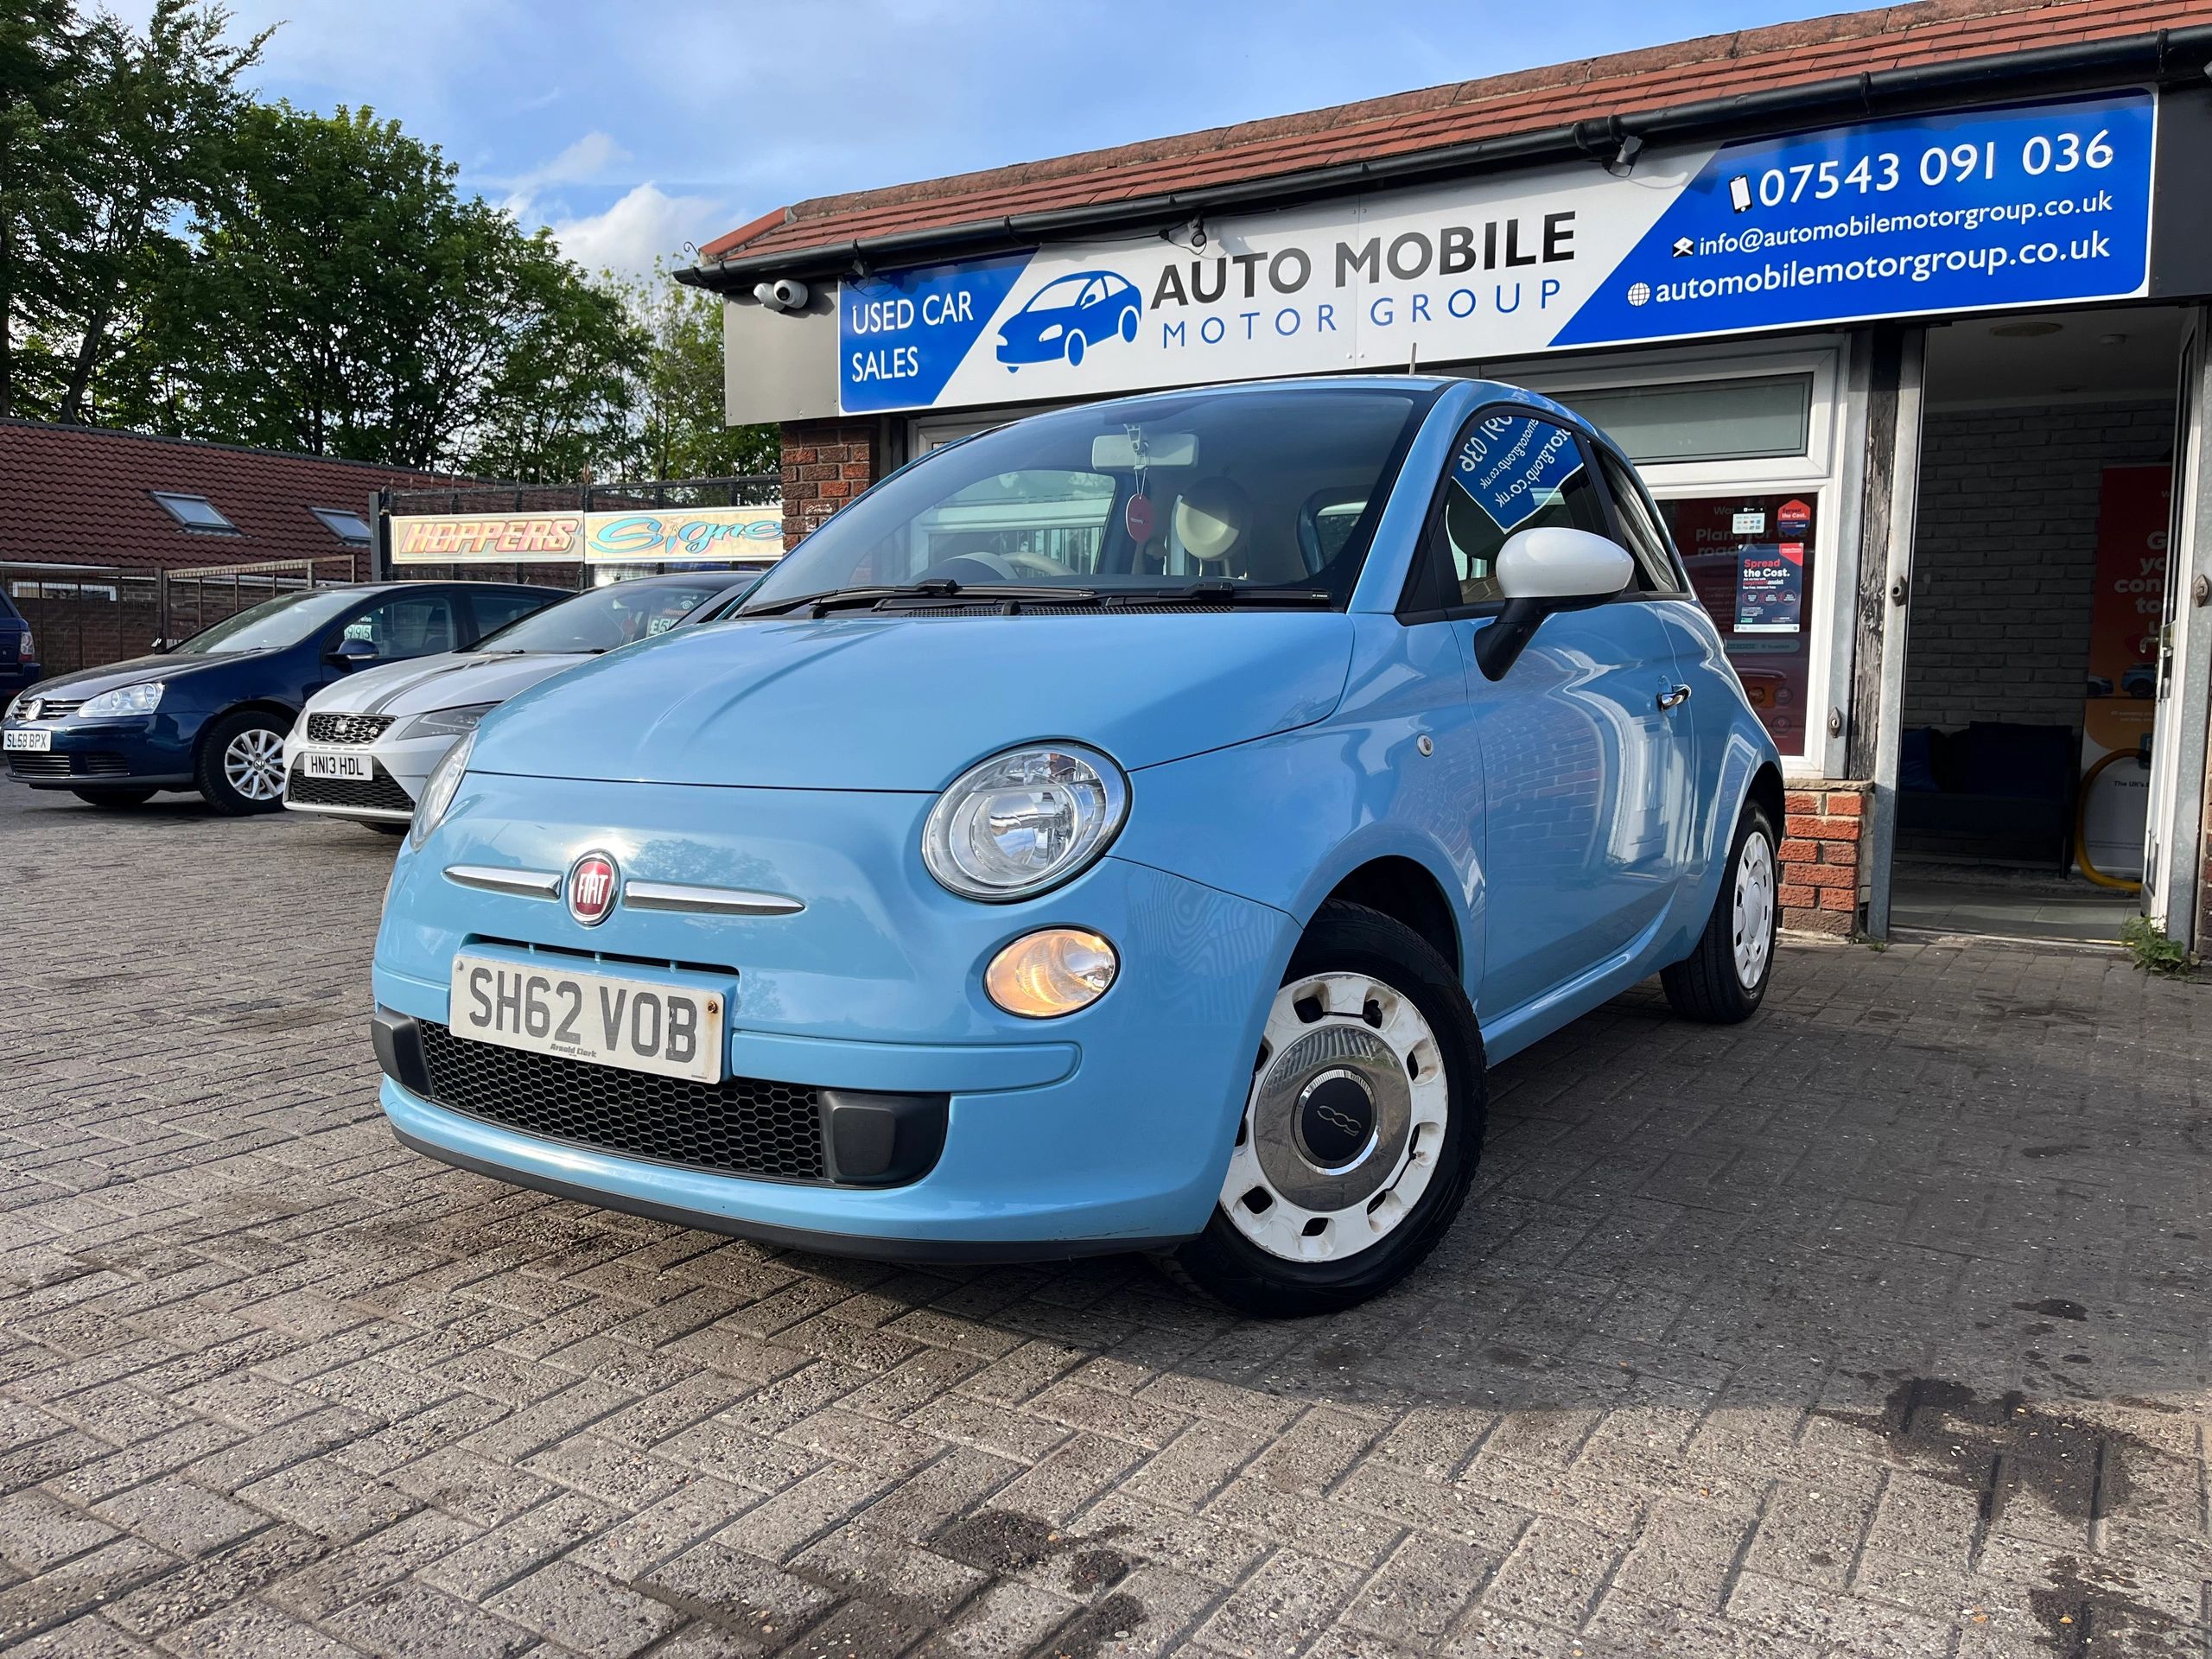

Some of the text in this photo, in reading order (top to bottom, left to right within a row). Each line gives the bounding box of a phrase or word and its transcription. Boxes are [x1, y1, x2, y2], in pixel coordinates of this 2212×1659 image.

[1758, 129, 2113, 207] 07543 091 036
[1699, 190, 2113, 256] info@automobilemotorgroup.co.uk
[1149, 211, 1576, 310] AUTO MOBILE
[1655, 230, 2112, 302] automobilemotorgroup.co.uk
[852, 290, 974, 334] USED CAR
[1163, 279, 1560, 349] MOTOR GROUP
[852, 346, 918, 383] SALES
[400, 518, 580, 554] HOPPERS
[589, 517, 783, 554] Signs
[1743, 568, 1790, 578] the Cost.
[1744, 558, 1781, 569] Spread
[7, 734, 47, 748] SL58 BPX
[311, 755, 364, 775] HN13 HDL
[576, 873, 608, 905] FIAT
[469, 967, 696, 1065] SH62 VOB
[550, 1043, 575, 1054] Arnold
